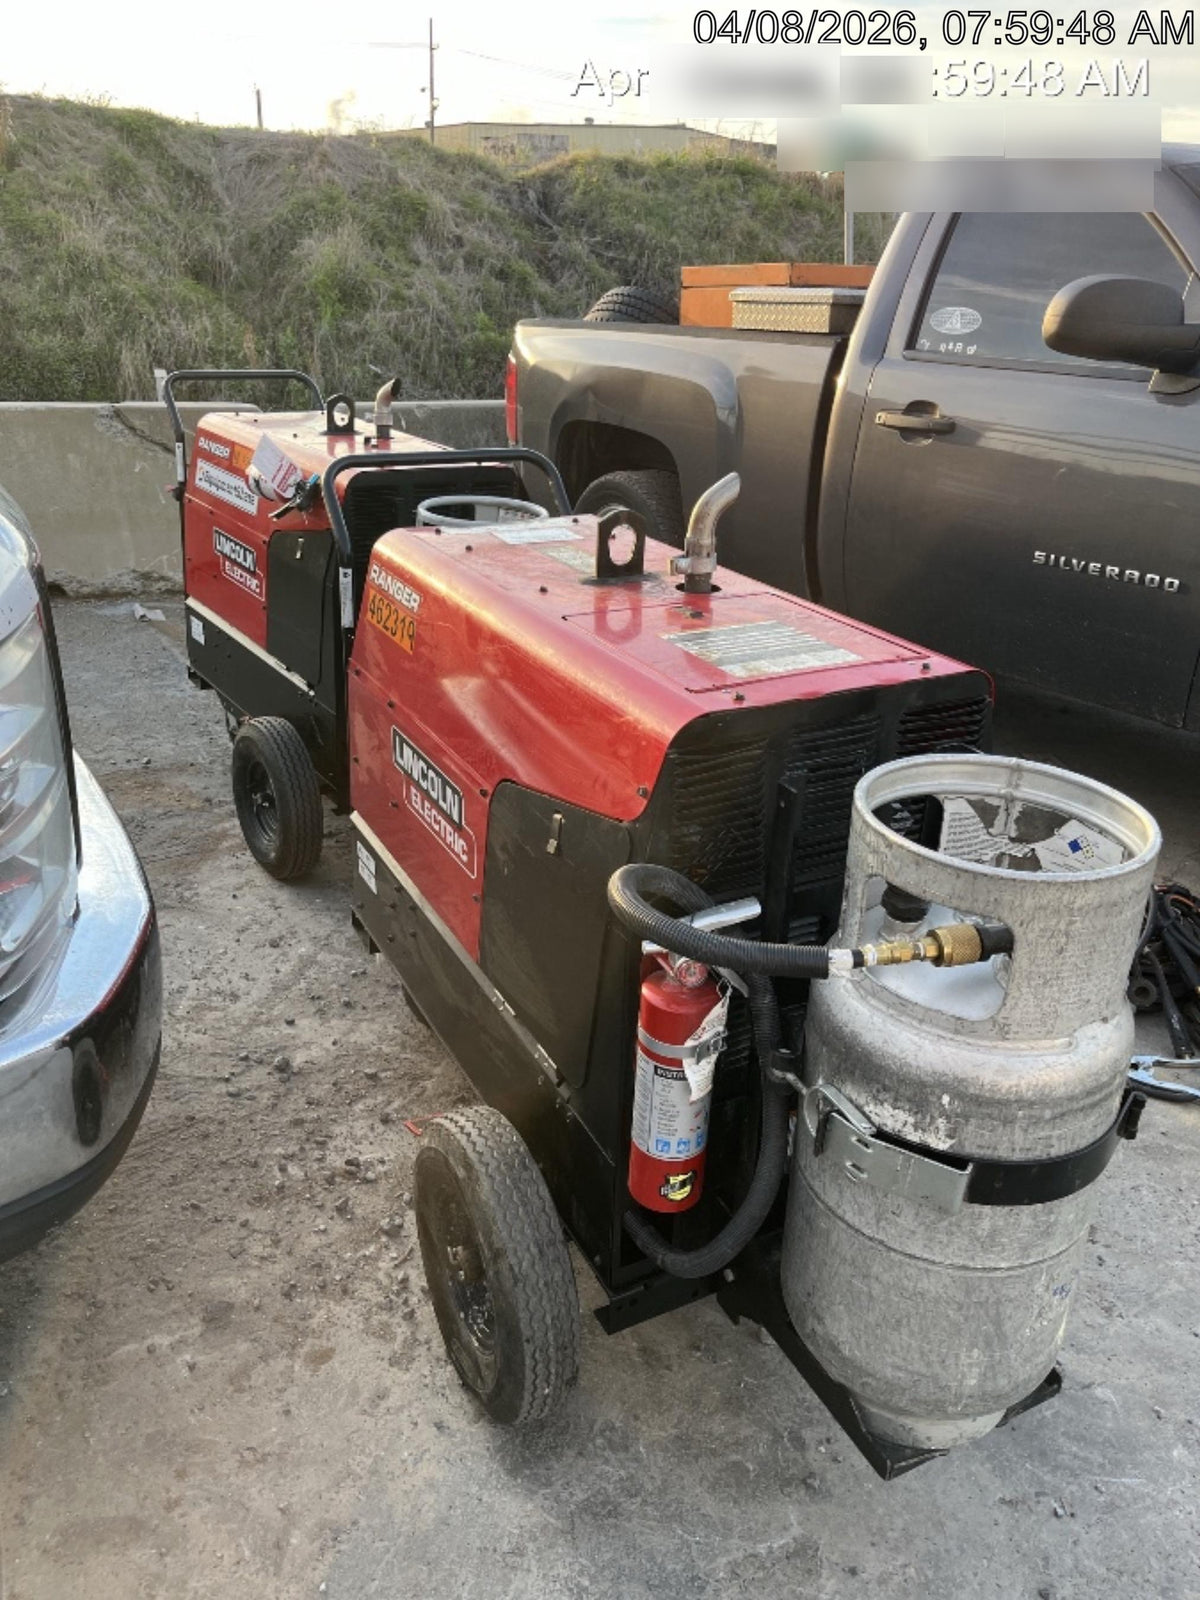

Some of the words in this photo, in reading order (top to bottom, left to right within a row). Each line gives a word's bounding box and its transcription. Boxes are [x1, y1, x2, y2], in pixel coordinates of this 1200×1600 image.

[216, 533, 254, 571] LINCOLN
[225, 560, 261, 593] ELECTRIC
[1032, 550, 1181, 593] SILVERADO
[370, 563, 421, 613] RANGER
[369, 592, 416, 652] 462319
[395, 734, 461, 824] LINCOLN
[410, 787, 468, 863] ELECTRIC
